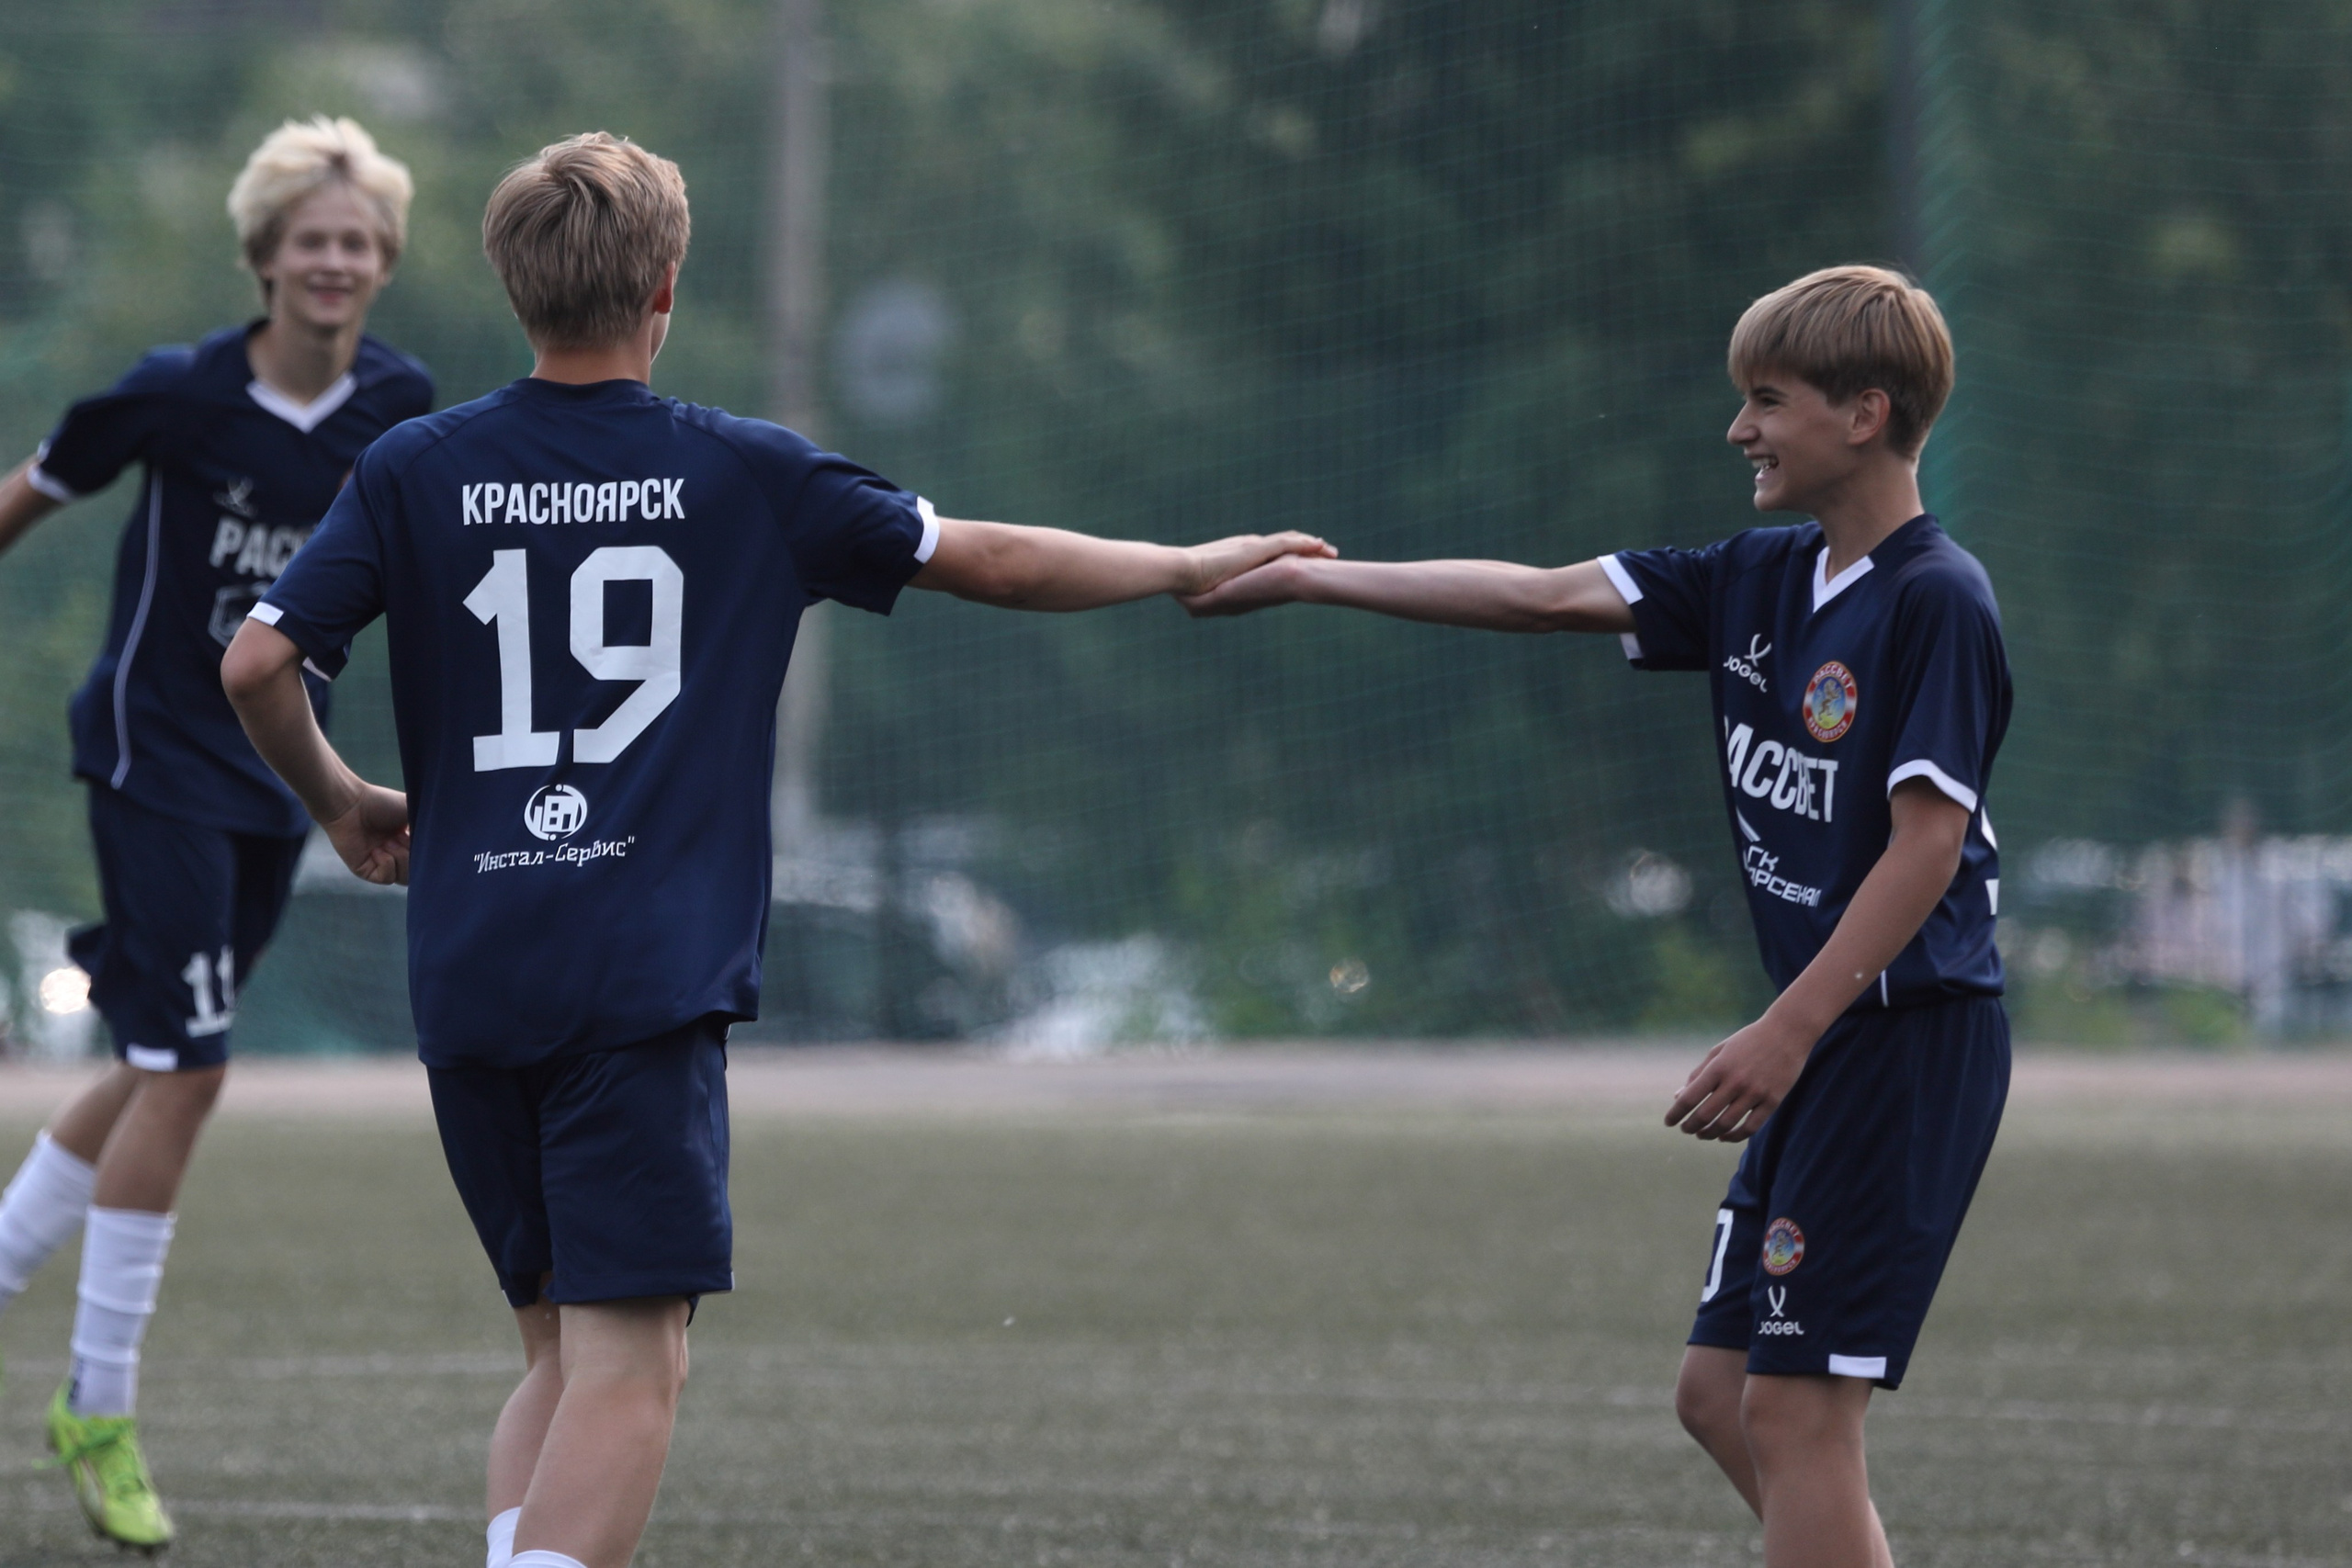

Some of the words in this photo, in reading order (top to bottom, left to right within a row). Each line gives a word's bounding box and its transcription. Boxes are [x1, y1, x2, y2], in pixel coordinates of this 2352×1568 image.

[462, 478, 685, 525] КРАСНОЯРСК
[462, 546, 684, 773] 19
[1724, 715, 1838, 823] АССВЕТ
[181, 944, 236, 1038] 11
